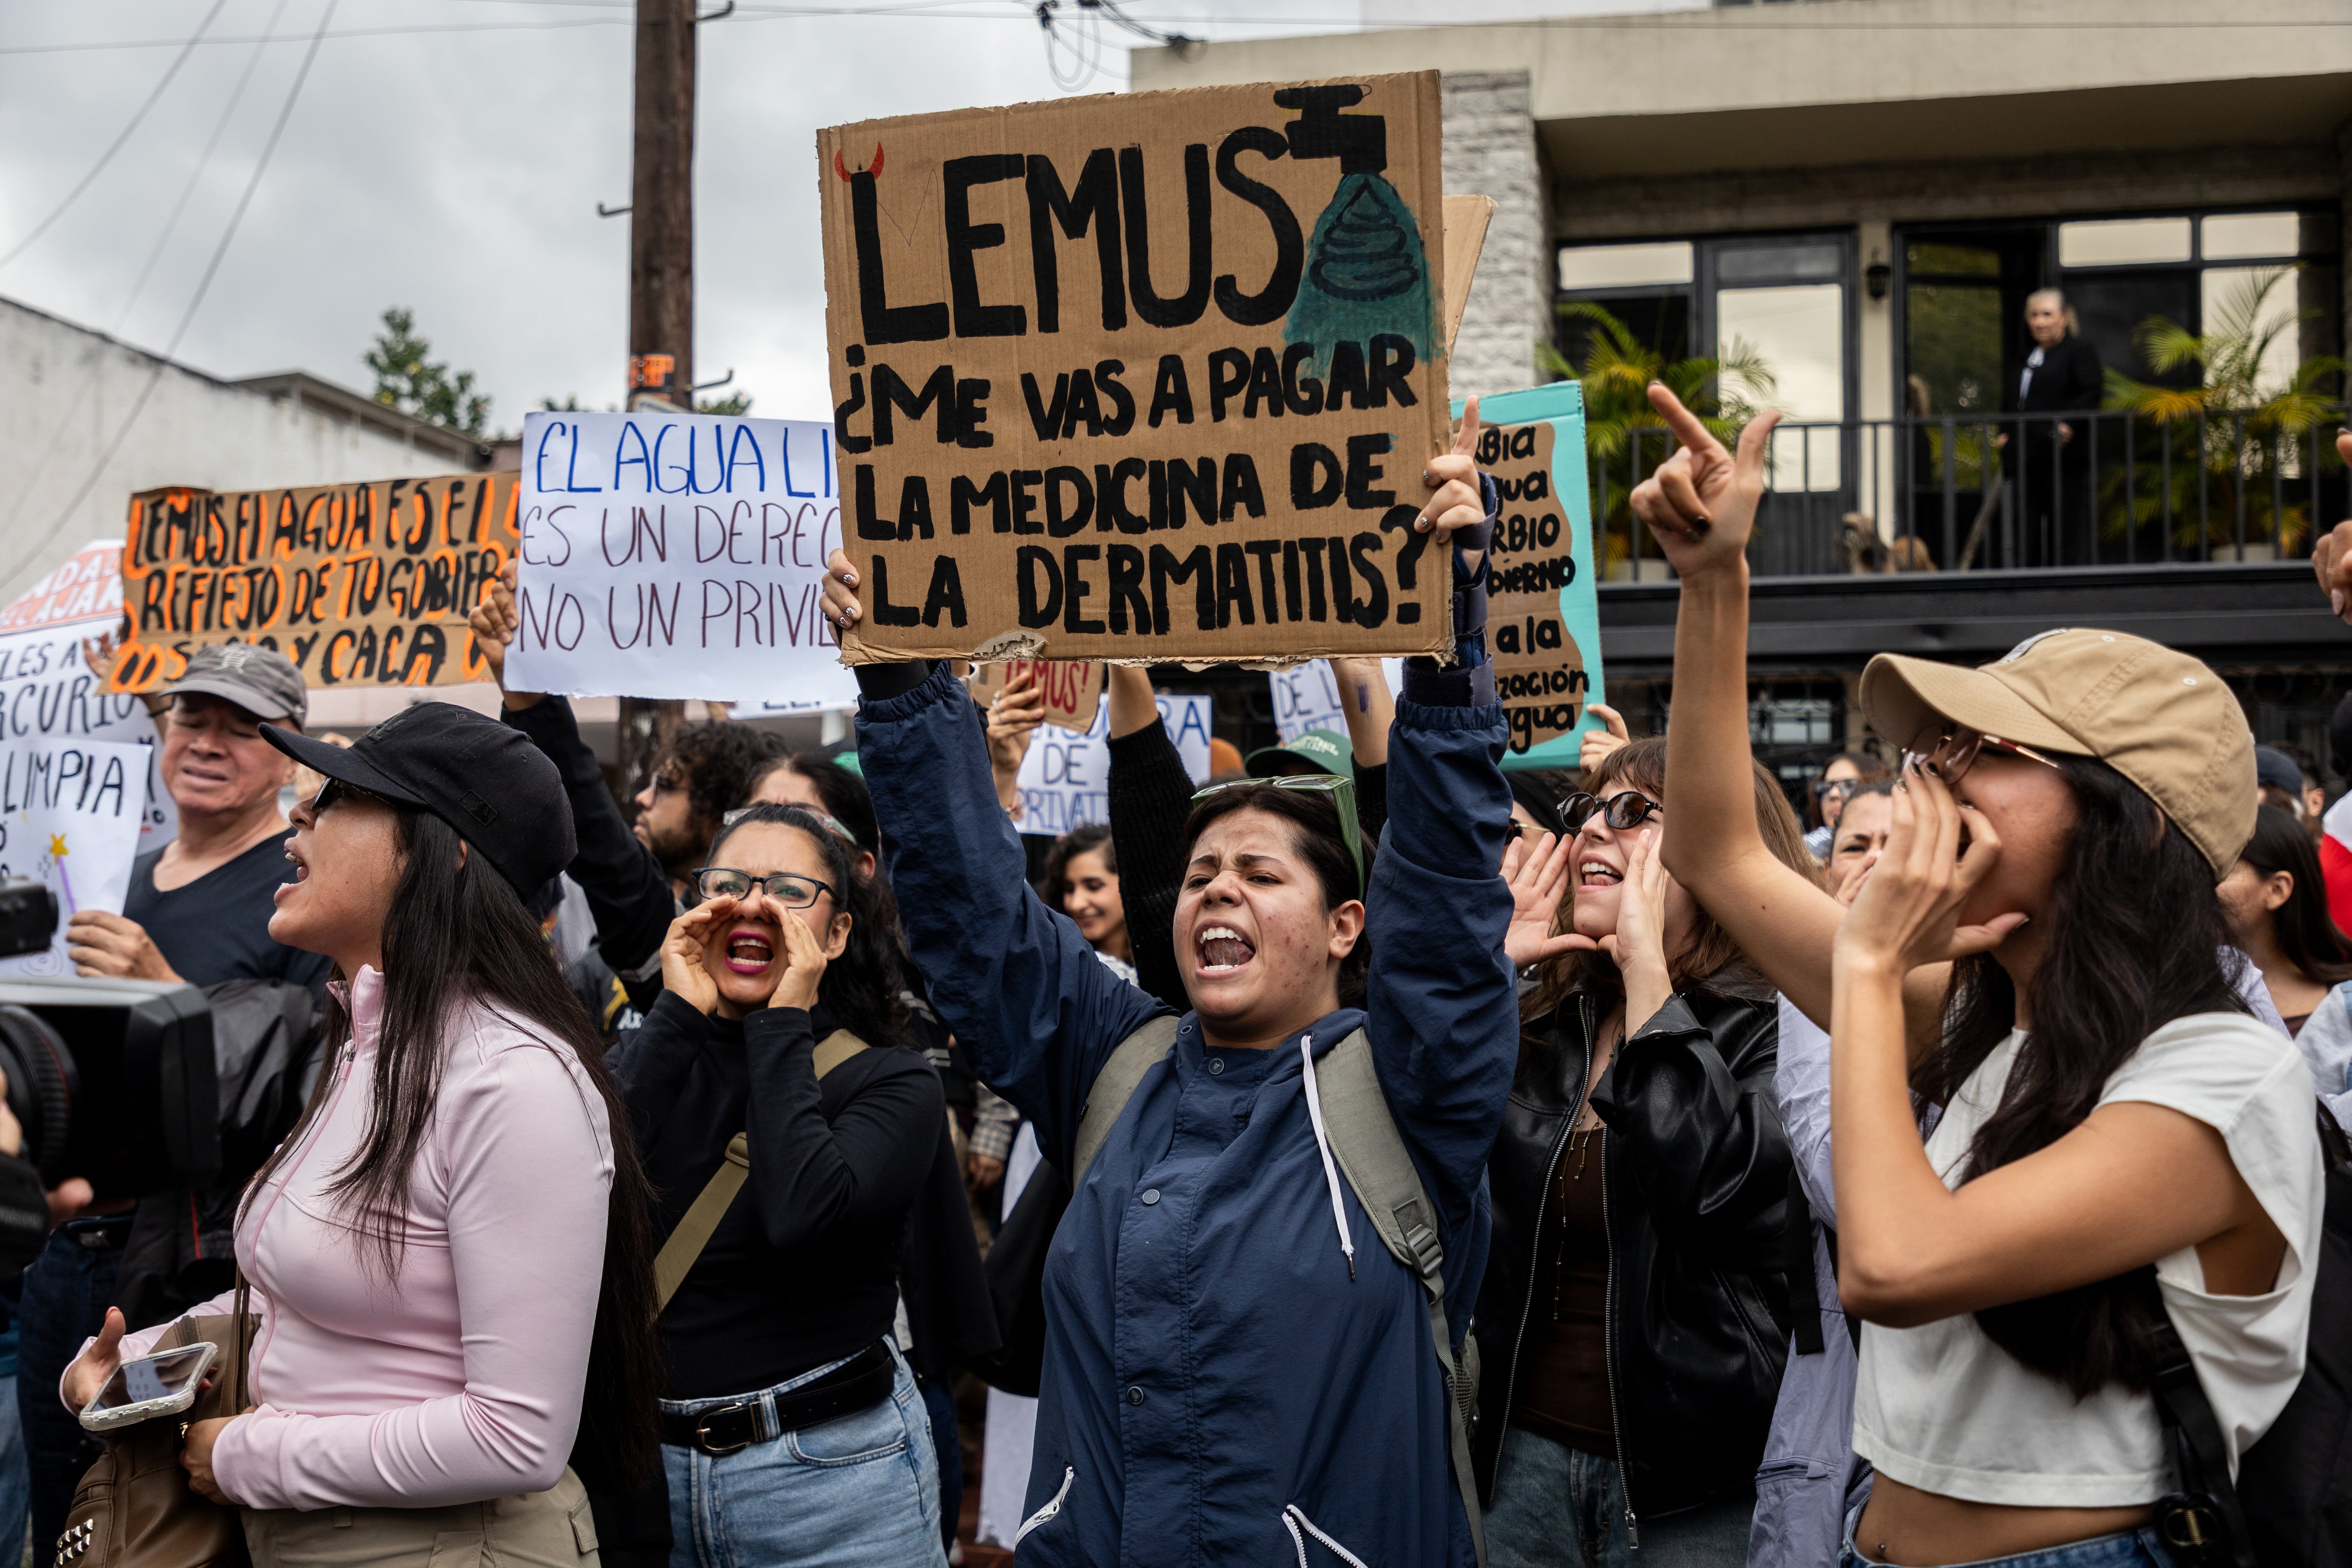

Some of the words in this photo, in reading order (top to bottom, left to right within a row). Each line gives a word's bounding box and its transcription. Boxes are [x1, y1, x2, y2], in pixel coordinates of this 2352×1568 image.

[851, 126, 1304, 345] LEMUS
[835, 343, 993, 454] ¿ME
[1021, 359, 1136, 441] VAS
[1149, 355, 1193, 428] A
[1208, 334, 1418, 422] PAGAR
[537, 422, 602, 493] EL
[614, 422, 765, 496] AGUA
[783, 428, 839, 498] LI
[856, 465, 934, 541] LA
[951, 454, 1266, 538] MEDICINA
[1290, 433, 1397, 509] DE
[524, 505, 576, 566] ES
[602, 505, 666, 566] UN
[873, 555, 968, 628] LA
[1017, 505, 1422, 635] DERMATITIS?
[388, 541, 519, 621] GOBIER
[520, 583, 584, 652] NO
[609, 582, 680, 649] UN
[1277, 673, 1312, 718] DE
[4, 750, 123, 817] LIMPIA
[1044, 743, 1089, 785] DE
